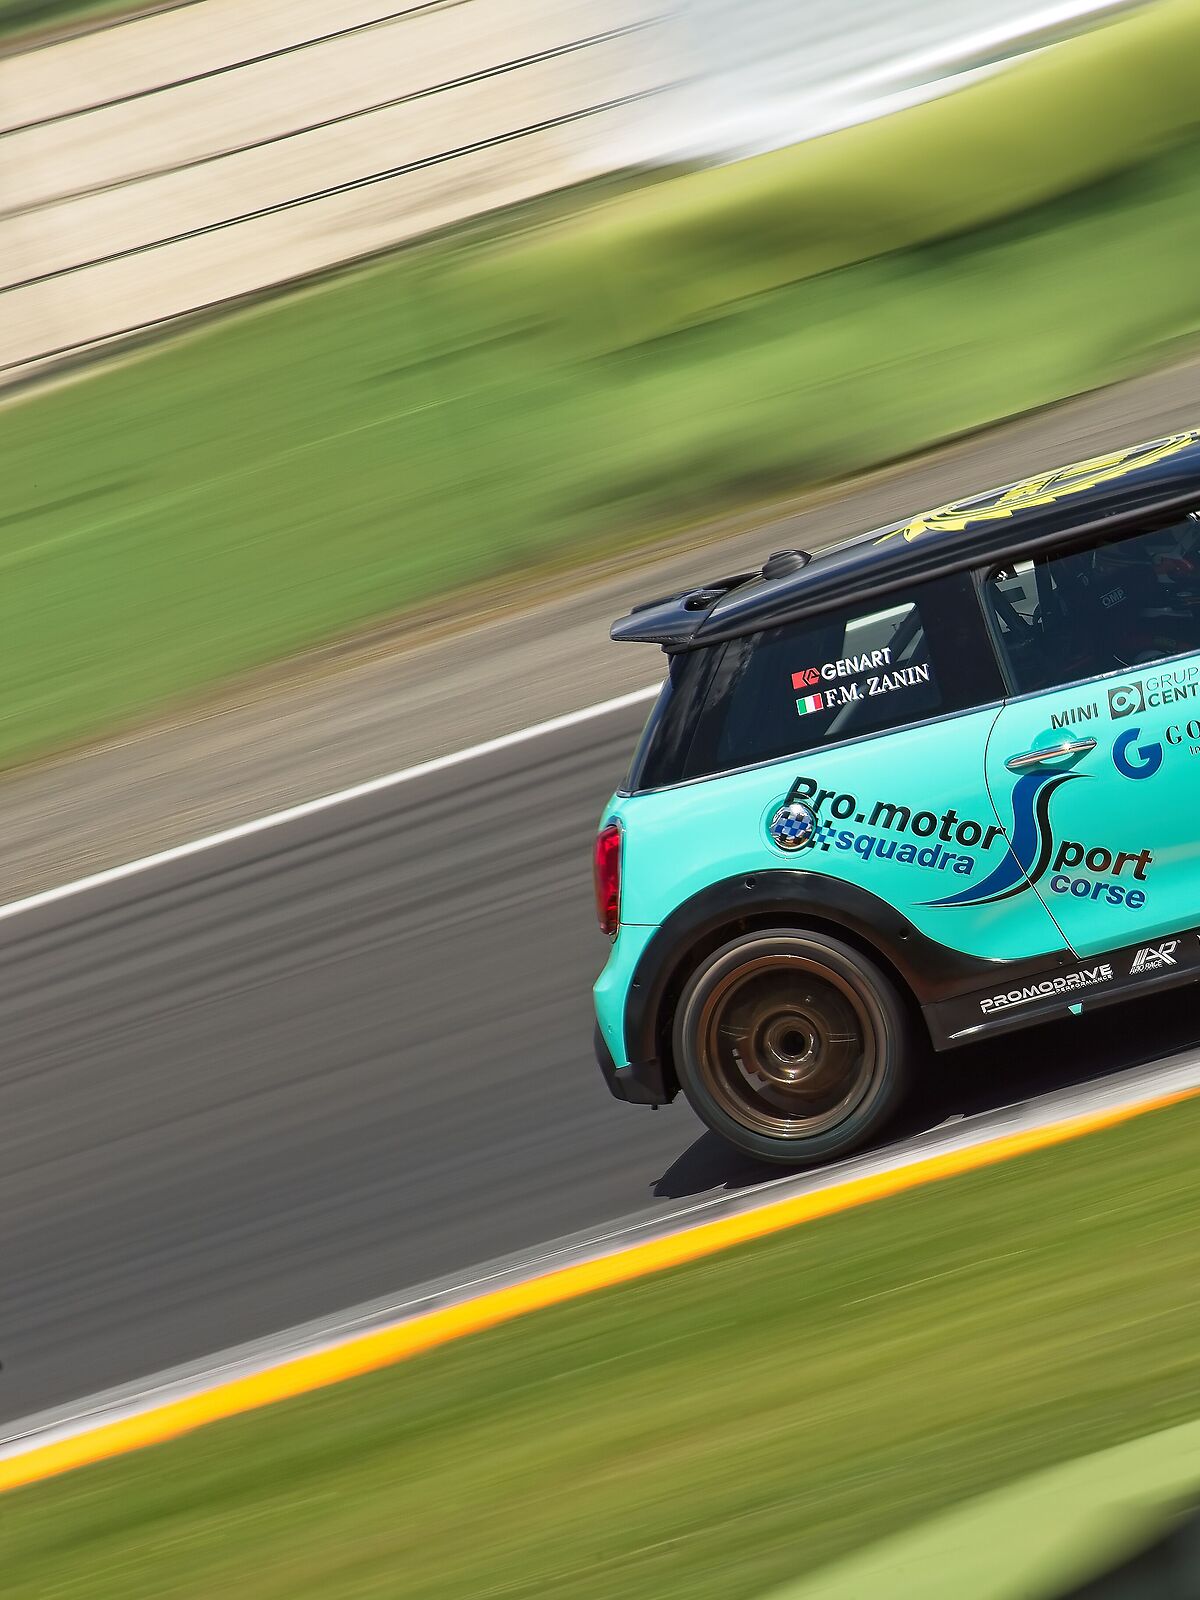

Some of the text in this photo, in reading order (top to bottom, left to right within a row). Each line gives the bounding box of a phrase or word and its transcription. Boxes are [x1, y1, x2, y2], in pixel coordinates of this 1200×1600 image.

[821, 648, 891, 681] GENART
[824, 663, 930, 708] F.M. ZANIN
[1050, 702, 1099, 730] MINI
[835, 828, 1147, 910] squadra corse
[980, 964, 1113, 1013] PROMODRIVE
[1056, 973, 1113, 995] PERFORMANCE
